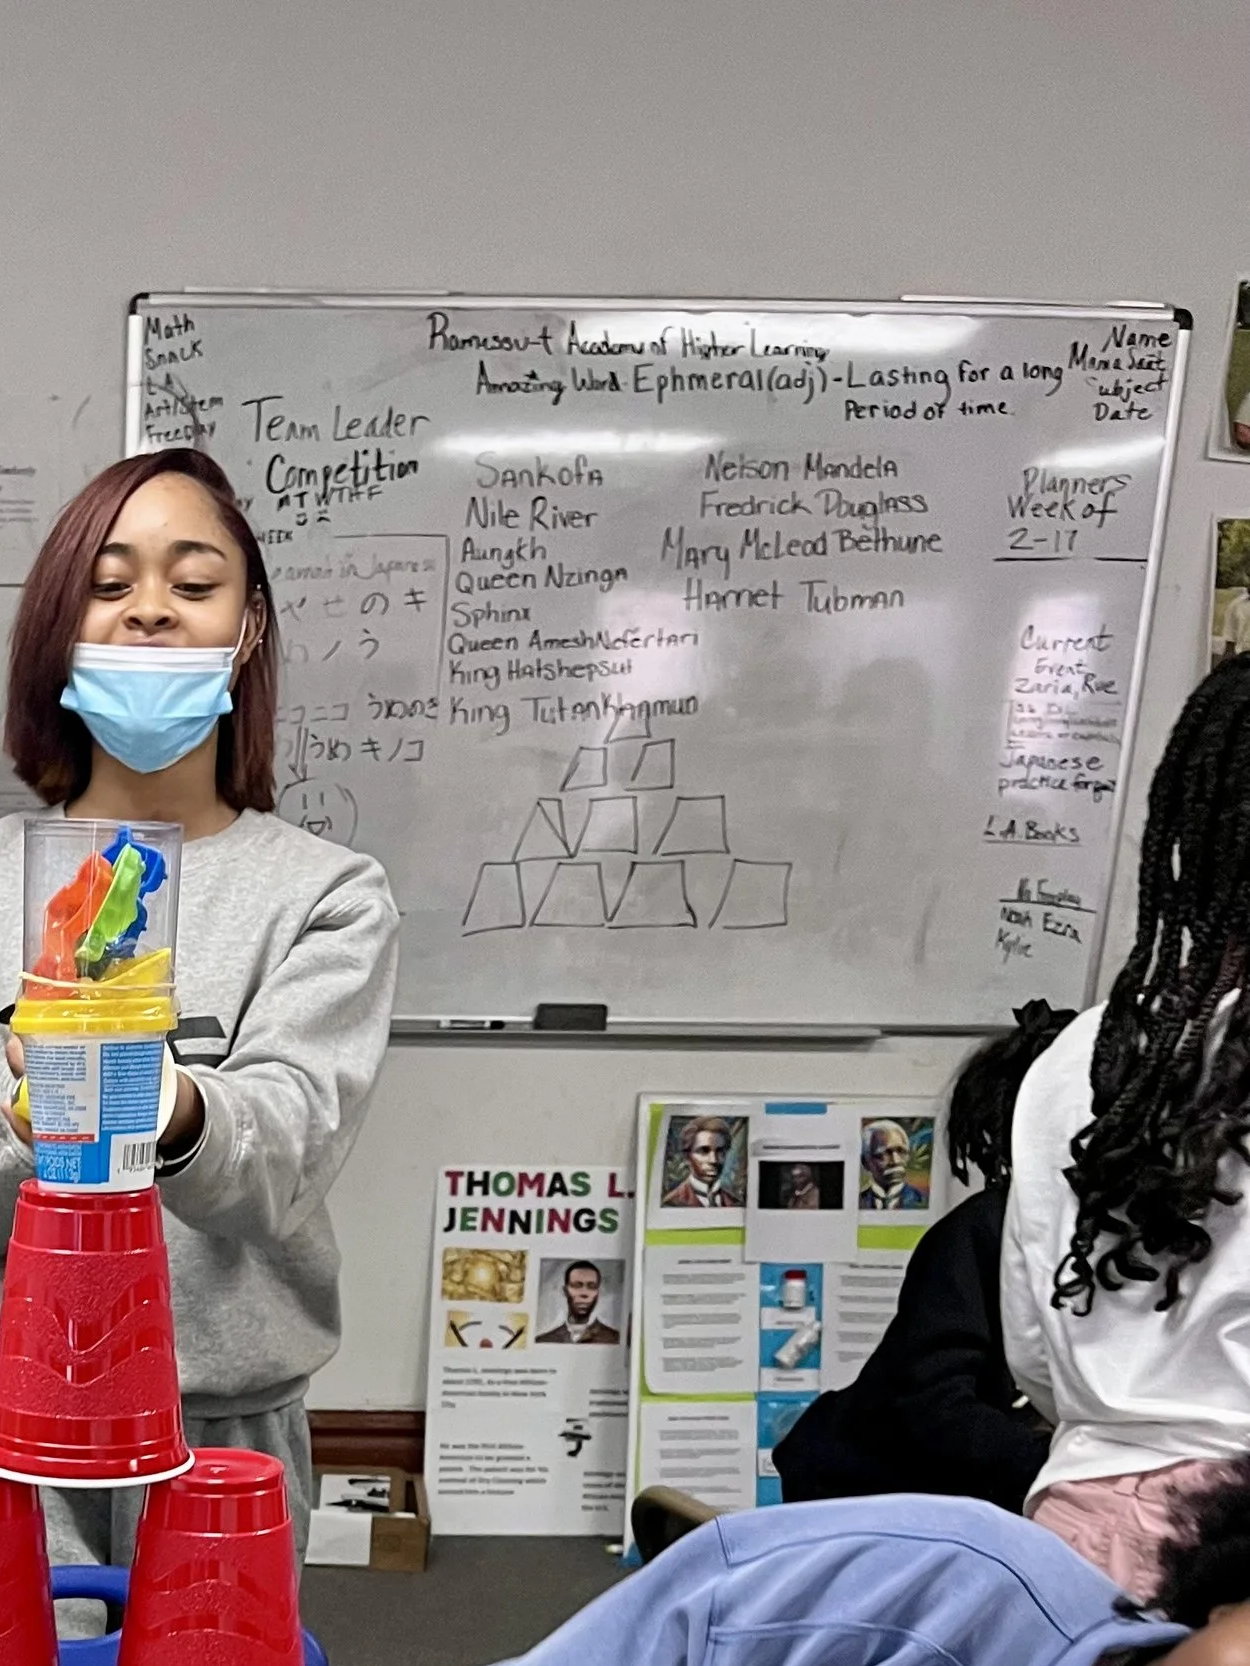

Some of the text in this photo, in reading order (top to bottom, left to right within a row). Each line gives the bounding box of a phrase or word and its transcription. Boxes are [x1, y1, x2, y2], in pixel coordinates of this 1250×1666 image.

[144, 313, 195, 346] Math
[650, 326, 674, 355] of
[1102, 323, 1172, 353] Name
[958, 359, 990, 384] for
[1000, 365, 1014, 381] a
[1022, 362, 1064, 397] long
[241, 395, 430, 443] Team Leader
[1093, 402, 1154, 422] Date
[266, 447, 419, 499] Competition
[1023, 466, 1132, 496] Planners
[465, 495, 598, 532] Nile River
[700, 490, 812, 519] Fredrick
[1007, 495, 1076, 521] Week
[661, 526, 730, 581] Mary
[1008, 527, 1078, 552] 2-17
[455, 570, 537, 595] Queen
[448, 632, 519, 655] Queen
[1020, 624, 1113, 653] Current
[450, 660, 501, 691] King
[450, 695, 511, 736] King
[445, 1170, 635, 1199] THOMAS L.
[443, 1207, 619, 1235] JENNINGS
